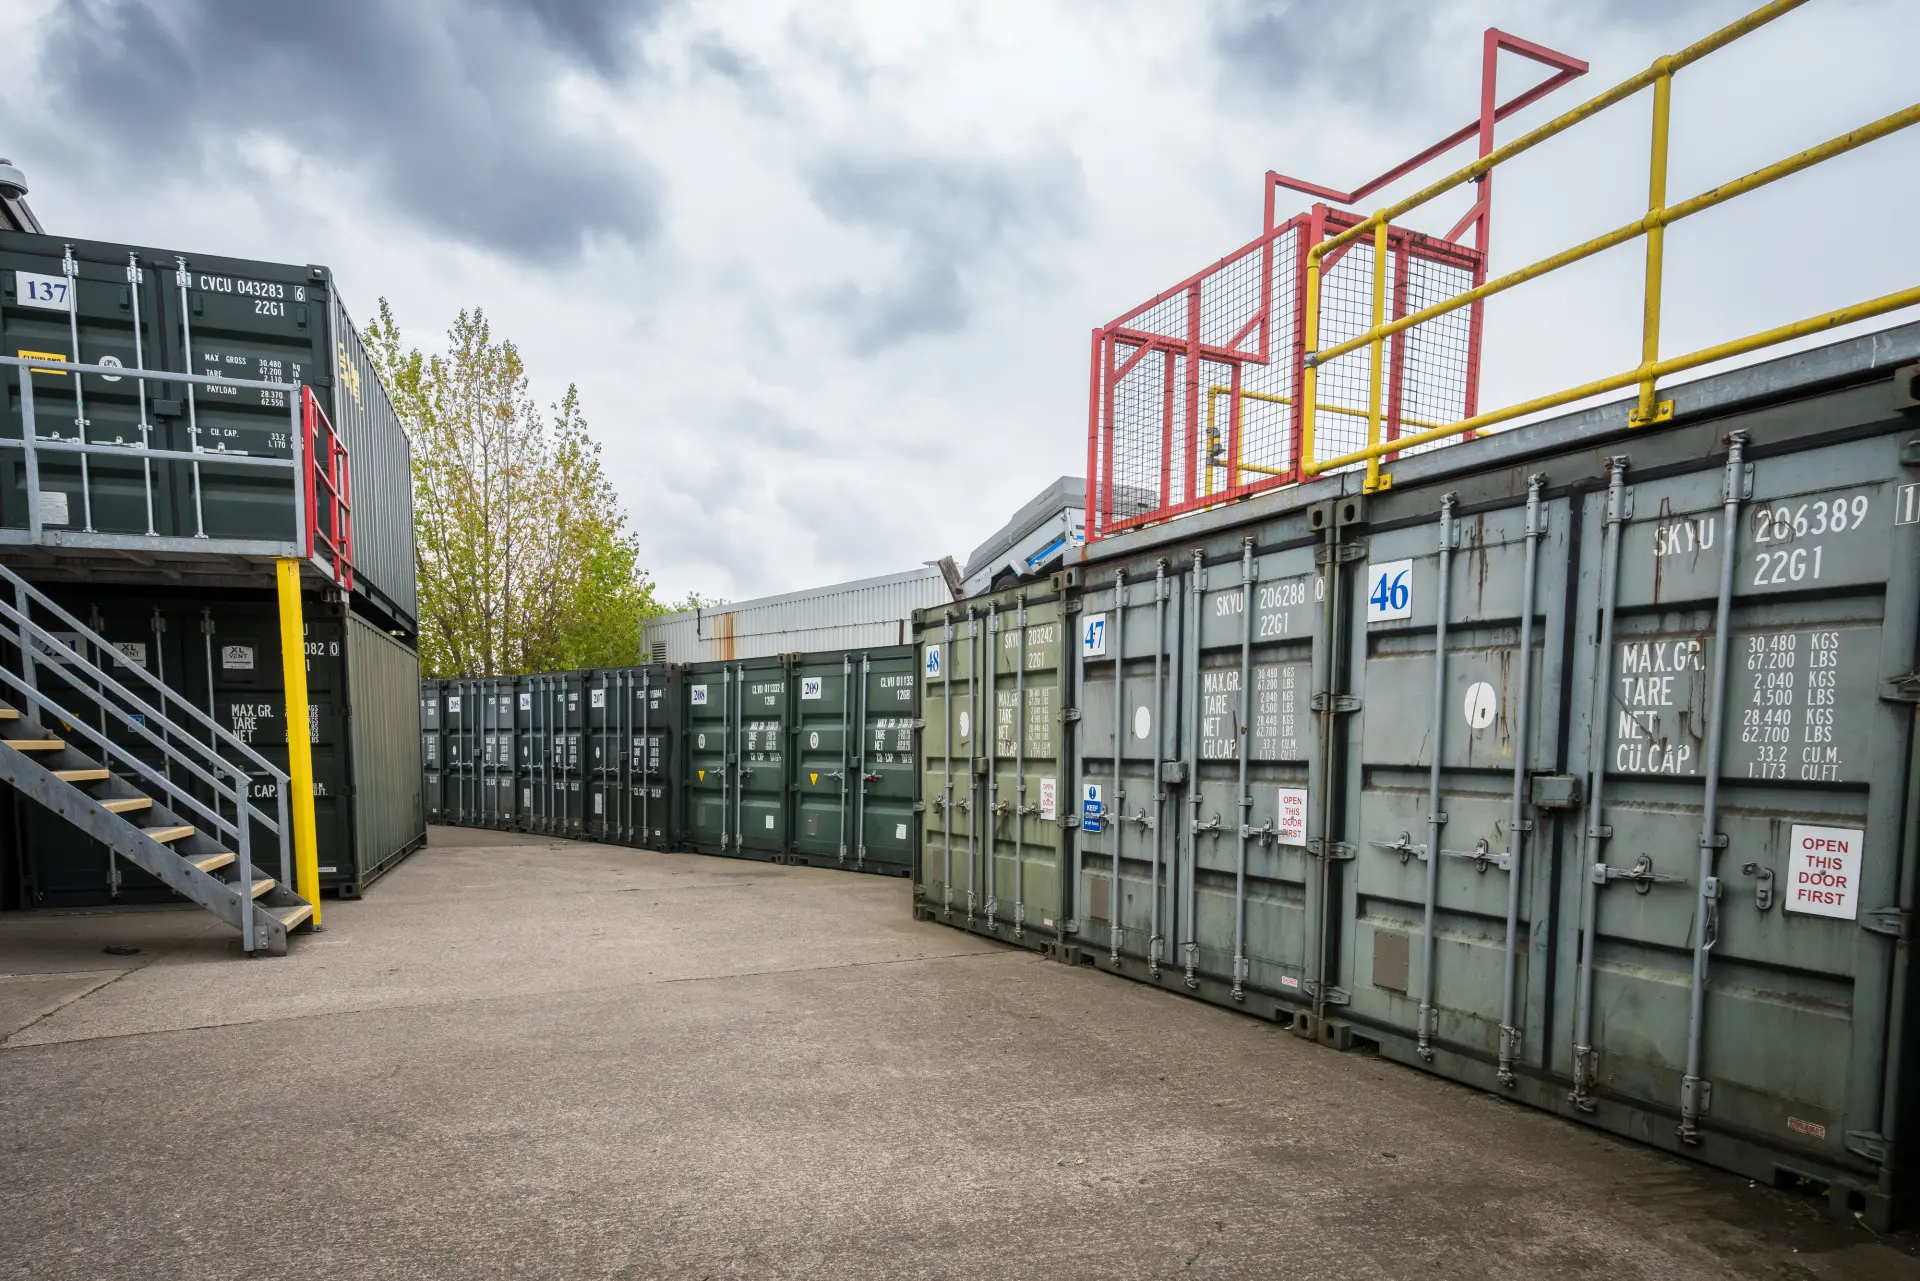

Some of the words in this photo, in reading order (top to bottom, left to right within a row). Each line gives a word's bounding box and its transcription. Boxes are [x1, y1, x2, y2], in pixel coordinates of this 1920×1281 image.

[27, 280, 67, 303] 137
[200, 275, 231, 293] CVCU
[237, 280, 284, 298] 043283
[296, 287, 304, 300] 6
[254, 300, 284, 316] 22G1
[204, 353, 220, 362] MAX
[226, 356, 246, 365] GROSS
[206, 368, 222, 378] TARE
[260, 367, 282, 376] 67.200
[206, 384, 236, 395] PAYLOAD
[210, 428, 222, 436] CU.
[224, 429, 240, 438] CAP.
[271, 432, 286, 441] 33.2
[1652, 517, 1715, 558] SKYU
[1754, 494, 1869, 544] 206389
[1904, 485, 1914, 522] 1
[1752, 545, 1823, 587] 22G1
[1370, 569, 1409, 612] 46
[1216, 592, 1244, 617] SKYU
[1260, 583, 1306, 610] 206288
[1260, 612, 1289, 637] 22G1
[1028, 626, 1052, 646] 203242
[1084, 620, 1104, 649] 47
[1748, 634, 1796, 653] 30.480
[1811, 632, 1839, 650] KGS
[926, 650, 939, 672] 48
[1028, 652, 1044, 668] 22G1
[1621, 640, 1705, 674] MAX.GR.
[1747, 652, 1795, 670] 67.200
[1809, 650, 1838, 668] LBS
[1257, 668, 1278, 680] 30.480
[1282, 667, 1295, 678] KGS
[1754, 672, 1794, 690] 2.040
[1808, 670, 1836, 688] KGS
[804, 682, 819, 694] 209
[1204, 672, 1242, 693] MAX.GR.
[1257, 679, 1278, 690] 67.200
[1282, 678, 1295, 690] LBS
[1622, 676, 1675, 706] TARE
[694, 690, 706, 700] 208
[1282, 690, 1294, 702] KGS
[1752, 690, 1792, 706] 4.500
[1807, 688, 1835, 706] LBS
[231, 704, 274, 718] MAX.GR.
[1204, 694, 1228, 714] TARE
[1282, 702, 1294, 713] LBS
[232, 716, 258, 730] TARE
[998, 708, 1012, 724] TARE
[1256, 715, 1278, 726] 28.440
[1282, 714, 1294, 726] KGS
[1744, 710, 1792, 726] 28.440
[1806, 708, 1834, 726] KGS
[998, 725, 1008, 740] NET
[1203, 718, 1221, 736] NET
[1256, 726, 1277, 737] 62.700
[1282, 726, 1294, 736] LBS
[1618, 710, 1658, 740] NET
[232, 730, 254, 742] NET
[1742, 726, 1790, 743] 62.700
[1804, 726, 1832, 743] LBS
[874, 740, 884, 750] NET
[1203, 739, 1238, 759] CU.CAP.
[1262, 739, 1276, 750] 33.2
[1616, 743, 1696, 775] CU.CAP.
[1757, 746, 1788, 762] 33.2
[1802, 746, 1843, 764] CU.M.
[1748, 762, 1786, 780] 1.173
[1801, 764, 1843, 782] CU.FT.
[254, 784, 278, 798] CAP.
[1284, 796, 1302, 805] OPEN
[1284, 807, 1300, 816] THIS
[1282, 818, 1302, 828] DOOR
[1802, 837, 1849, 854] OPEN
[1806, 855, 1843, 870] THIS
[1798, 871, 1848, 888] DOOR
[1797, 888, 1846, 906] FIRST
